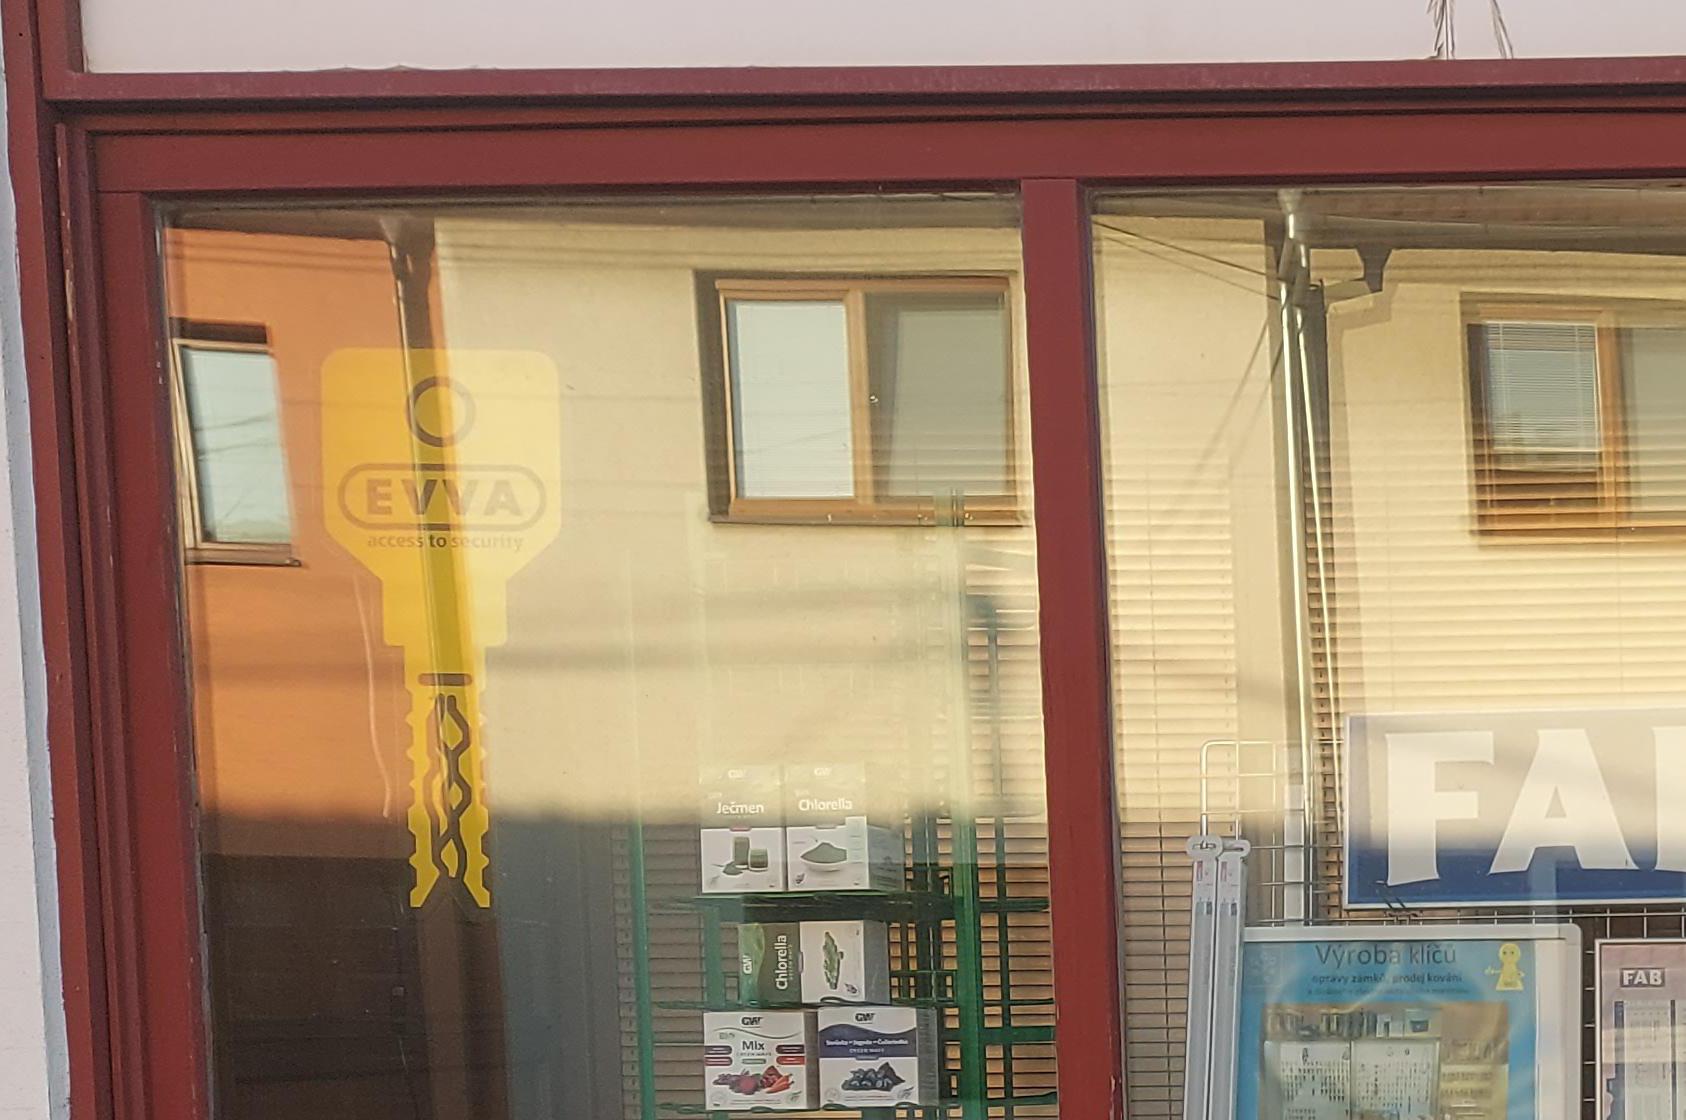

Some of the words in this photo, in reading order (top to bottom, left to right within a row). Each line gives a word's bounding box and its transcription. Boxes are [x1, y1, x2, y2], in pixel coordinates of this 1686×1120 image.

[366, 478, 523, 517] EVVA
[367, 534, 424, 549] access
[429, 533, 448, 549] to
[450, 533, 524, 551] security
[717, 800, 764, 815] Ječmen
[798, 799, 853, 812] Chlorella
[775, 934, 789, 991] Chlorella
[1314, 942, 1401, 972] Výroba
[1312, 974, 1350, 986] opravy
[1391, 972, 1426, 985] prodej
[1621, 969, 1664, 986] FAB
[742, 1039, 766, 1051] Mix
